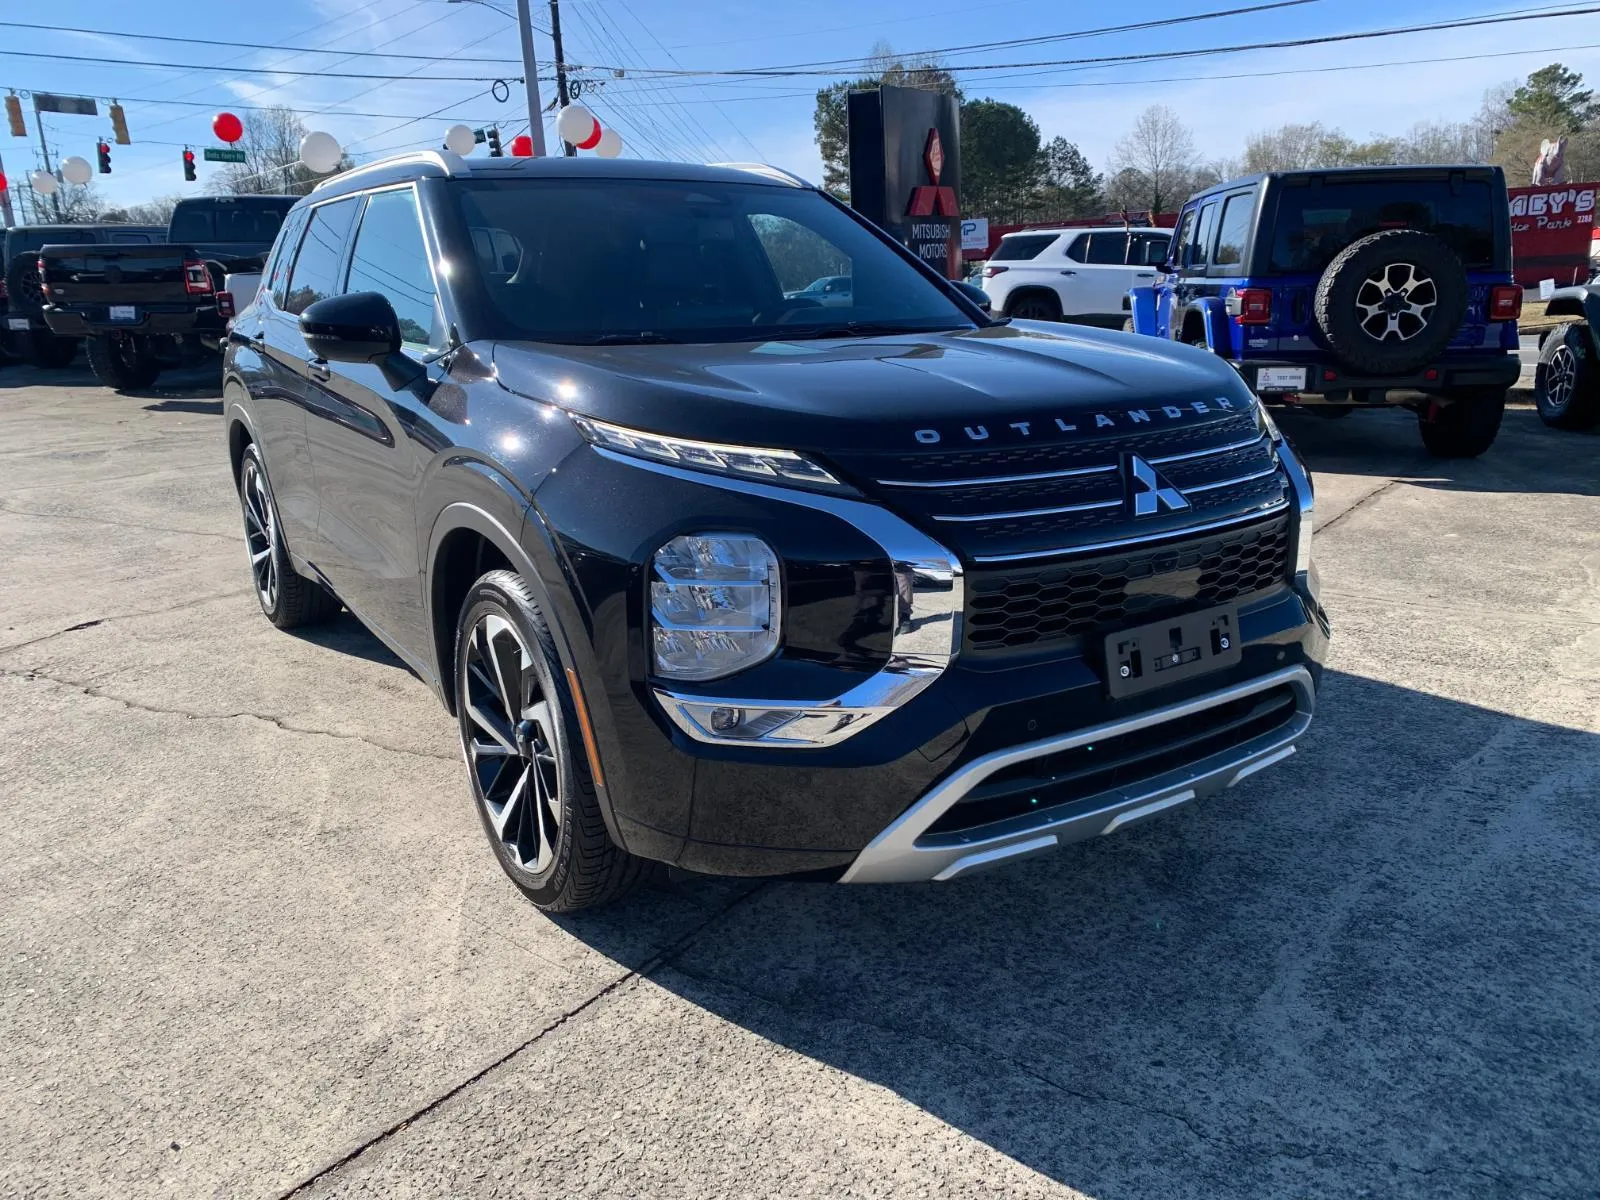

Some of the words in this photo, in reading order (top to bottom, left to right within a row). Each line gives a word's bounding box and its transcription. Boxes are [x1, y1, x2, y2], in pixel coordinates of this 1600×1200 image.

[1536, 216, 1573, 229] Park
[912, 224, 952, 239] MITSUBISH
[919, 243, 948, 259] MOTORS
[914, 397, 1235, 443] OUTLANDER
